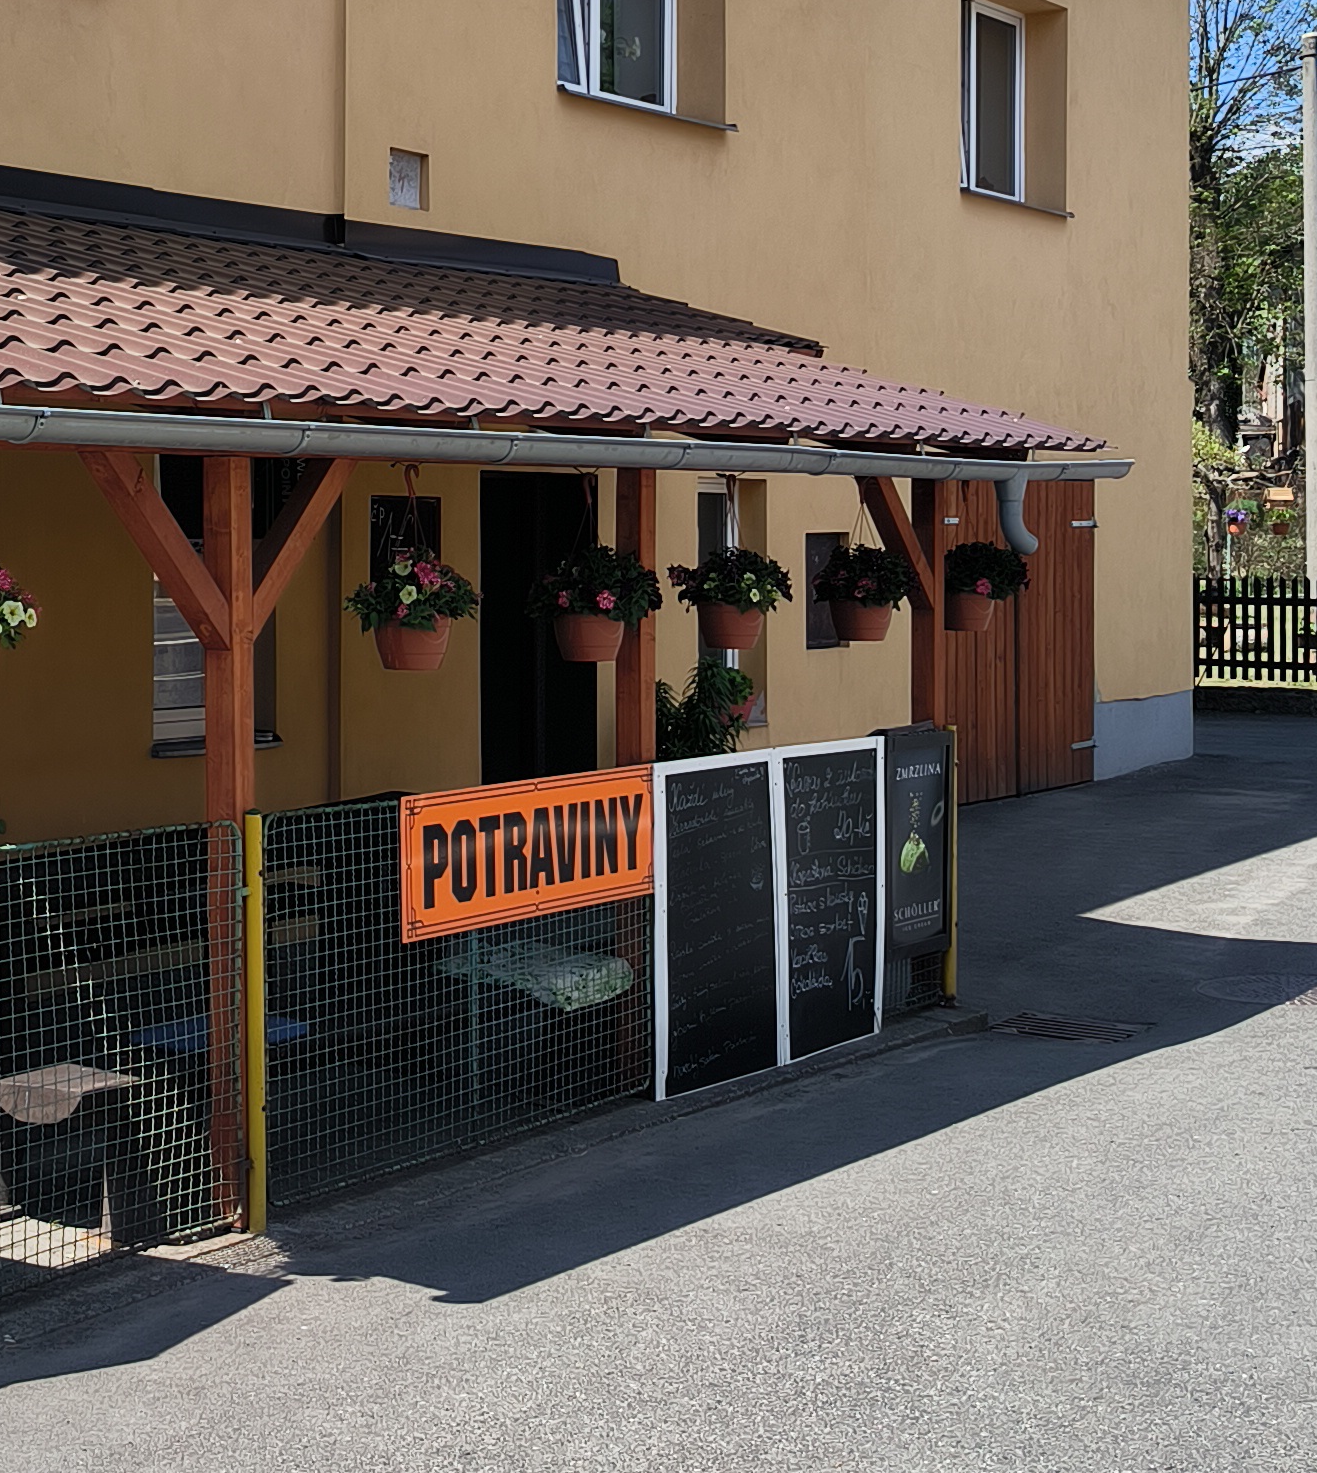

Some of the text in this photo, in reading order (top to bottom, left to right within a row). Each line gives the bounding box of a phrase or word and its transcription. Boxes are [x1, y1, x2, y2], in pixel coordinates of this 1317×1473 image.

[895, 762, 941, 781] ZMRZLINA
[422, 793, 644, 909] POTRAVINY
[893, 899, 940, 923] SCHÖLLER
